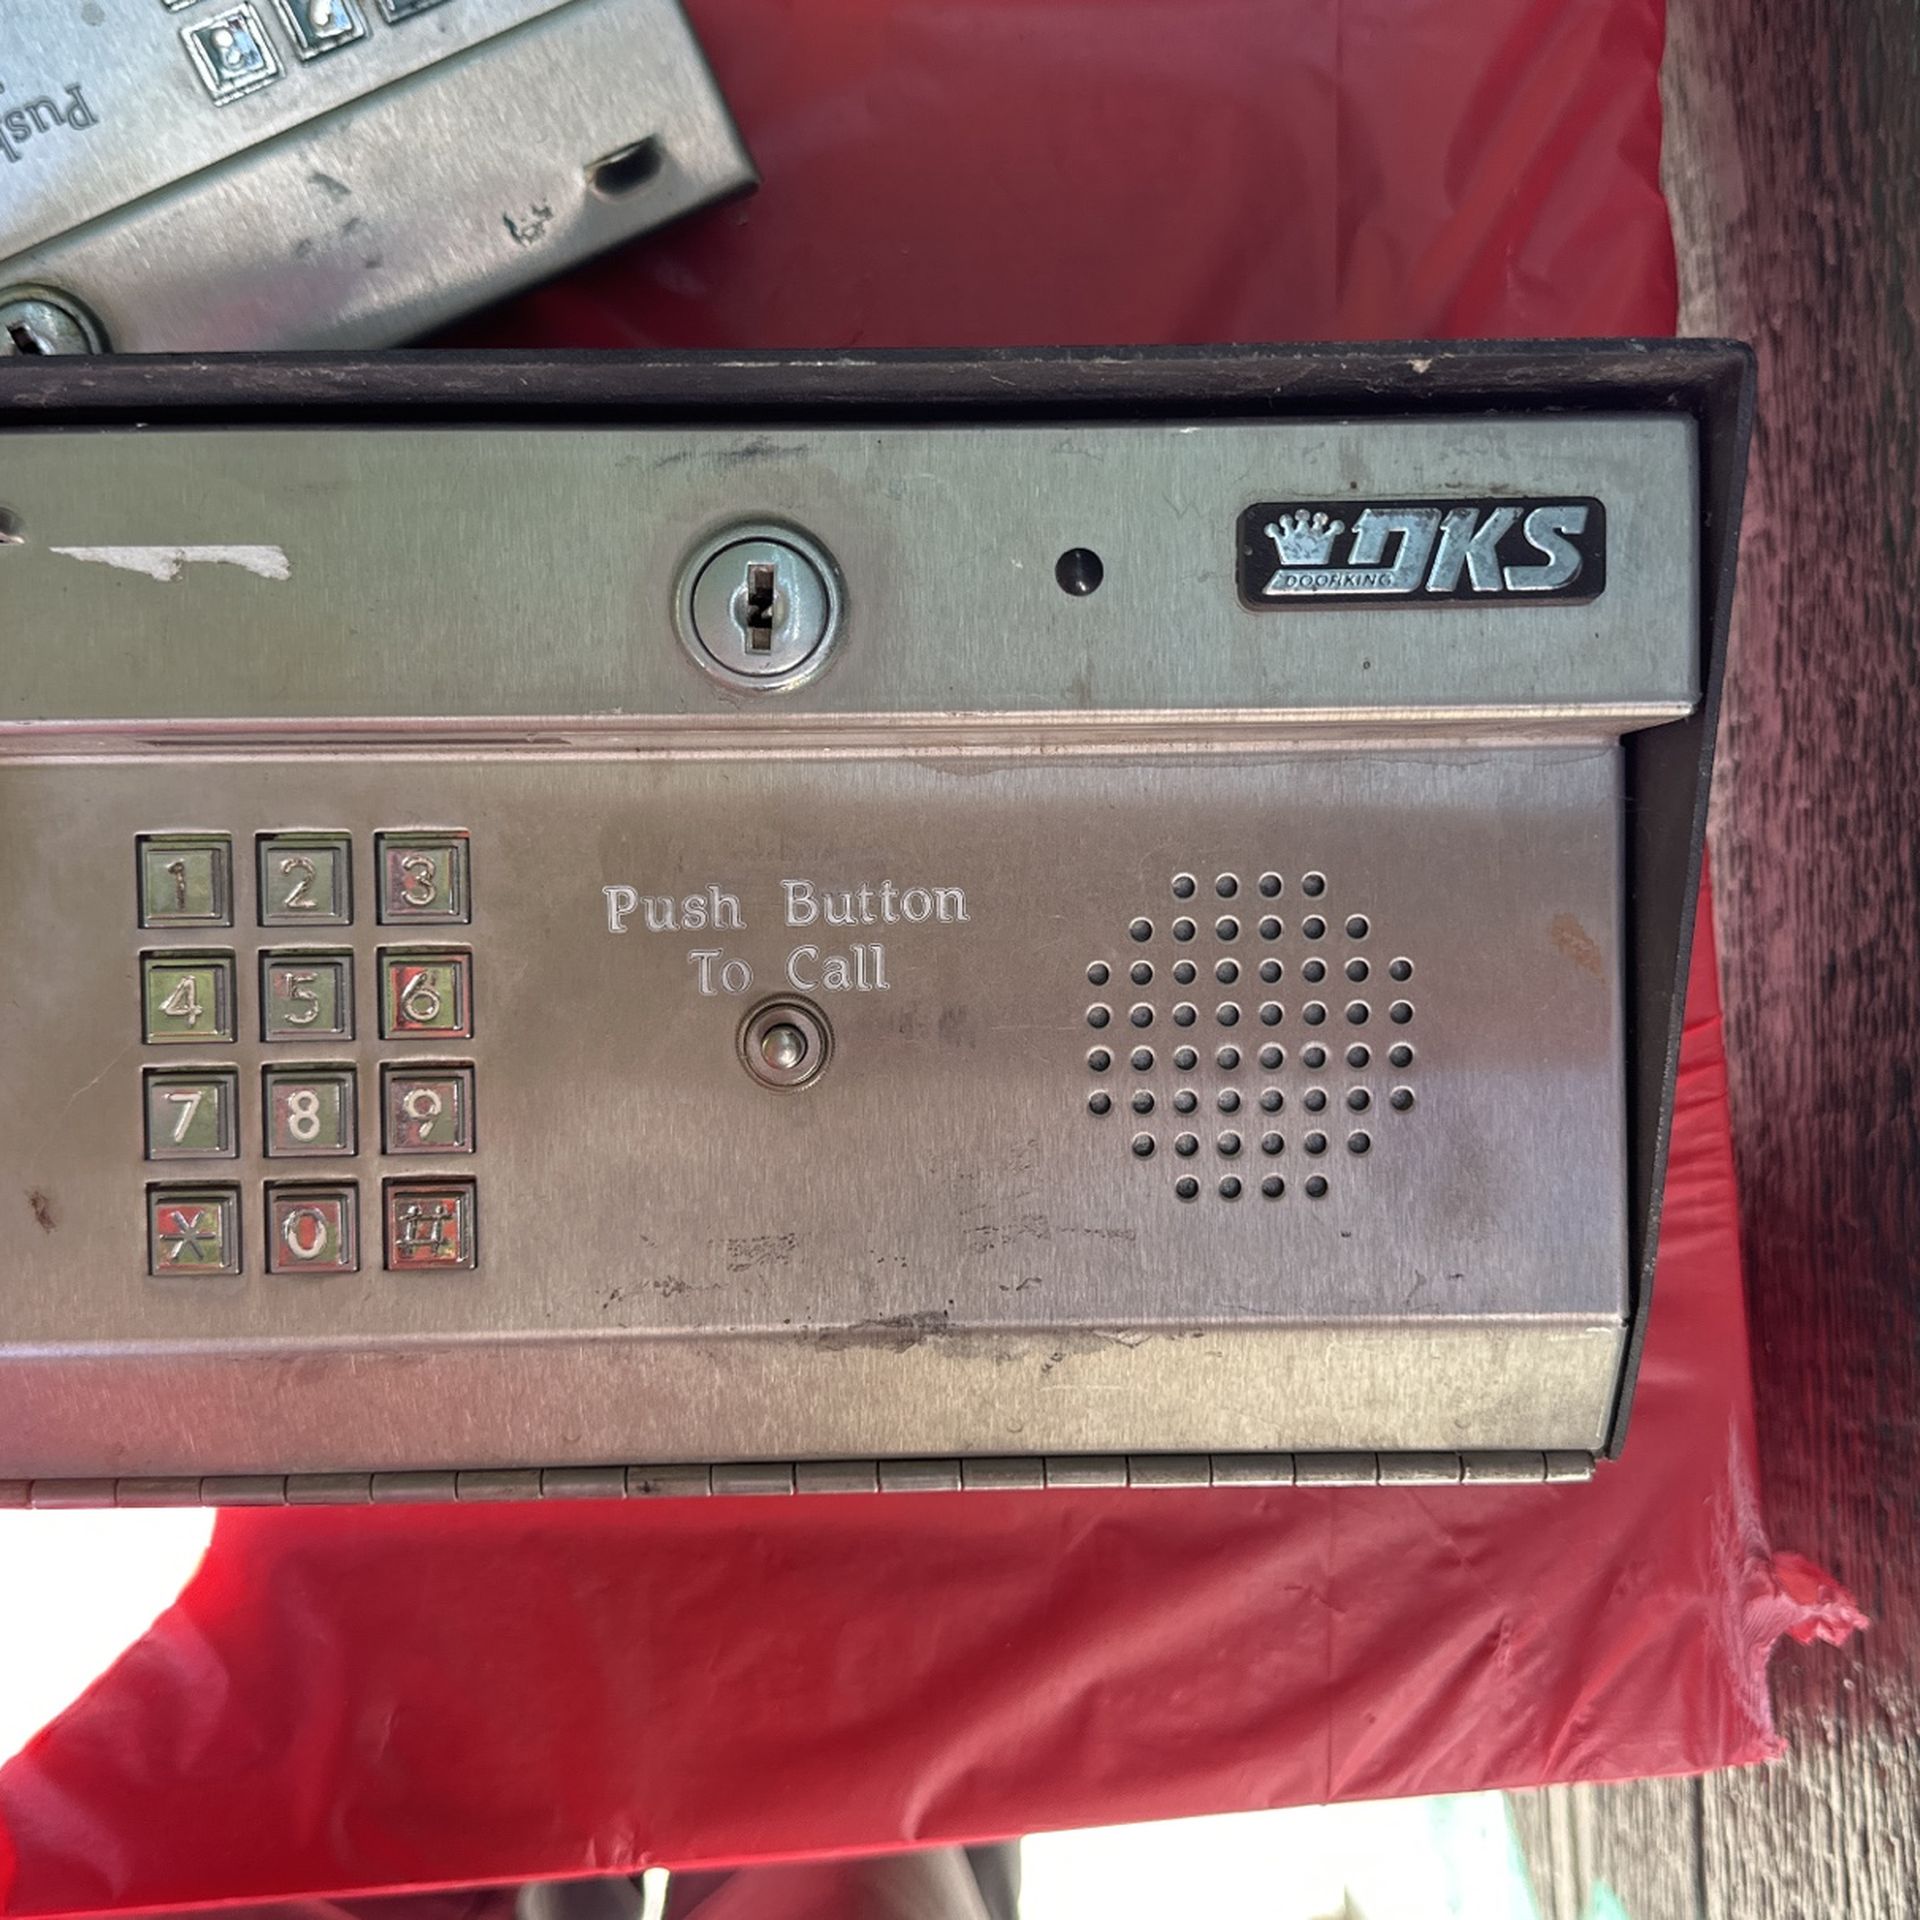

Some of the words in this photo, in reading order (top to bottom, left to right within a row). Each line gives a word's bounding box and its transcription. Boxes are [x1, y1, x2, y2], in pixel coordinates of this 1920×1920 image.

[1347, 506, 1590, 592] DKS
[1285, 573, 1394, 588] DOORKING
[166, 857, 187, 911] 1
[280, 856, 317, 909] 2
[401, 855, 437, 906] 3
[602, 883, 748, 933] Push
[780, 879, 971, 927] Button
[688, 947, 754, 996] To
[785, 943, 890, 992] Call
[158, 974, 204, 1028] 4
[283, 971, 320, 1025] 5
[401, 972, 441, 1022] 6
[163, 1090, 203, 1144] 7
[287, 1089, 321, 1141] 8
[403, 1087, 442, 1139] 9
